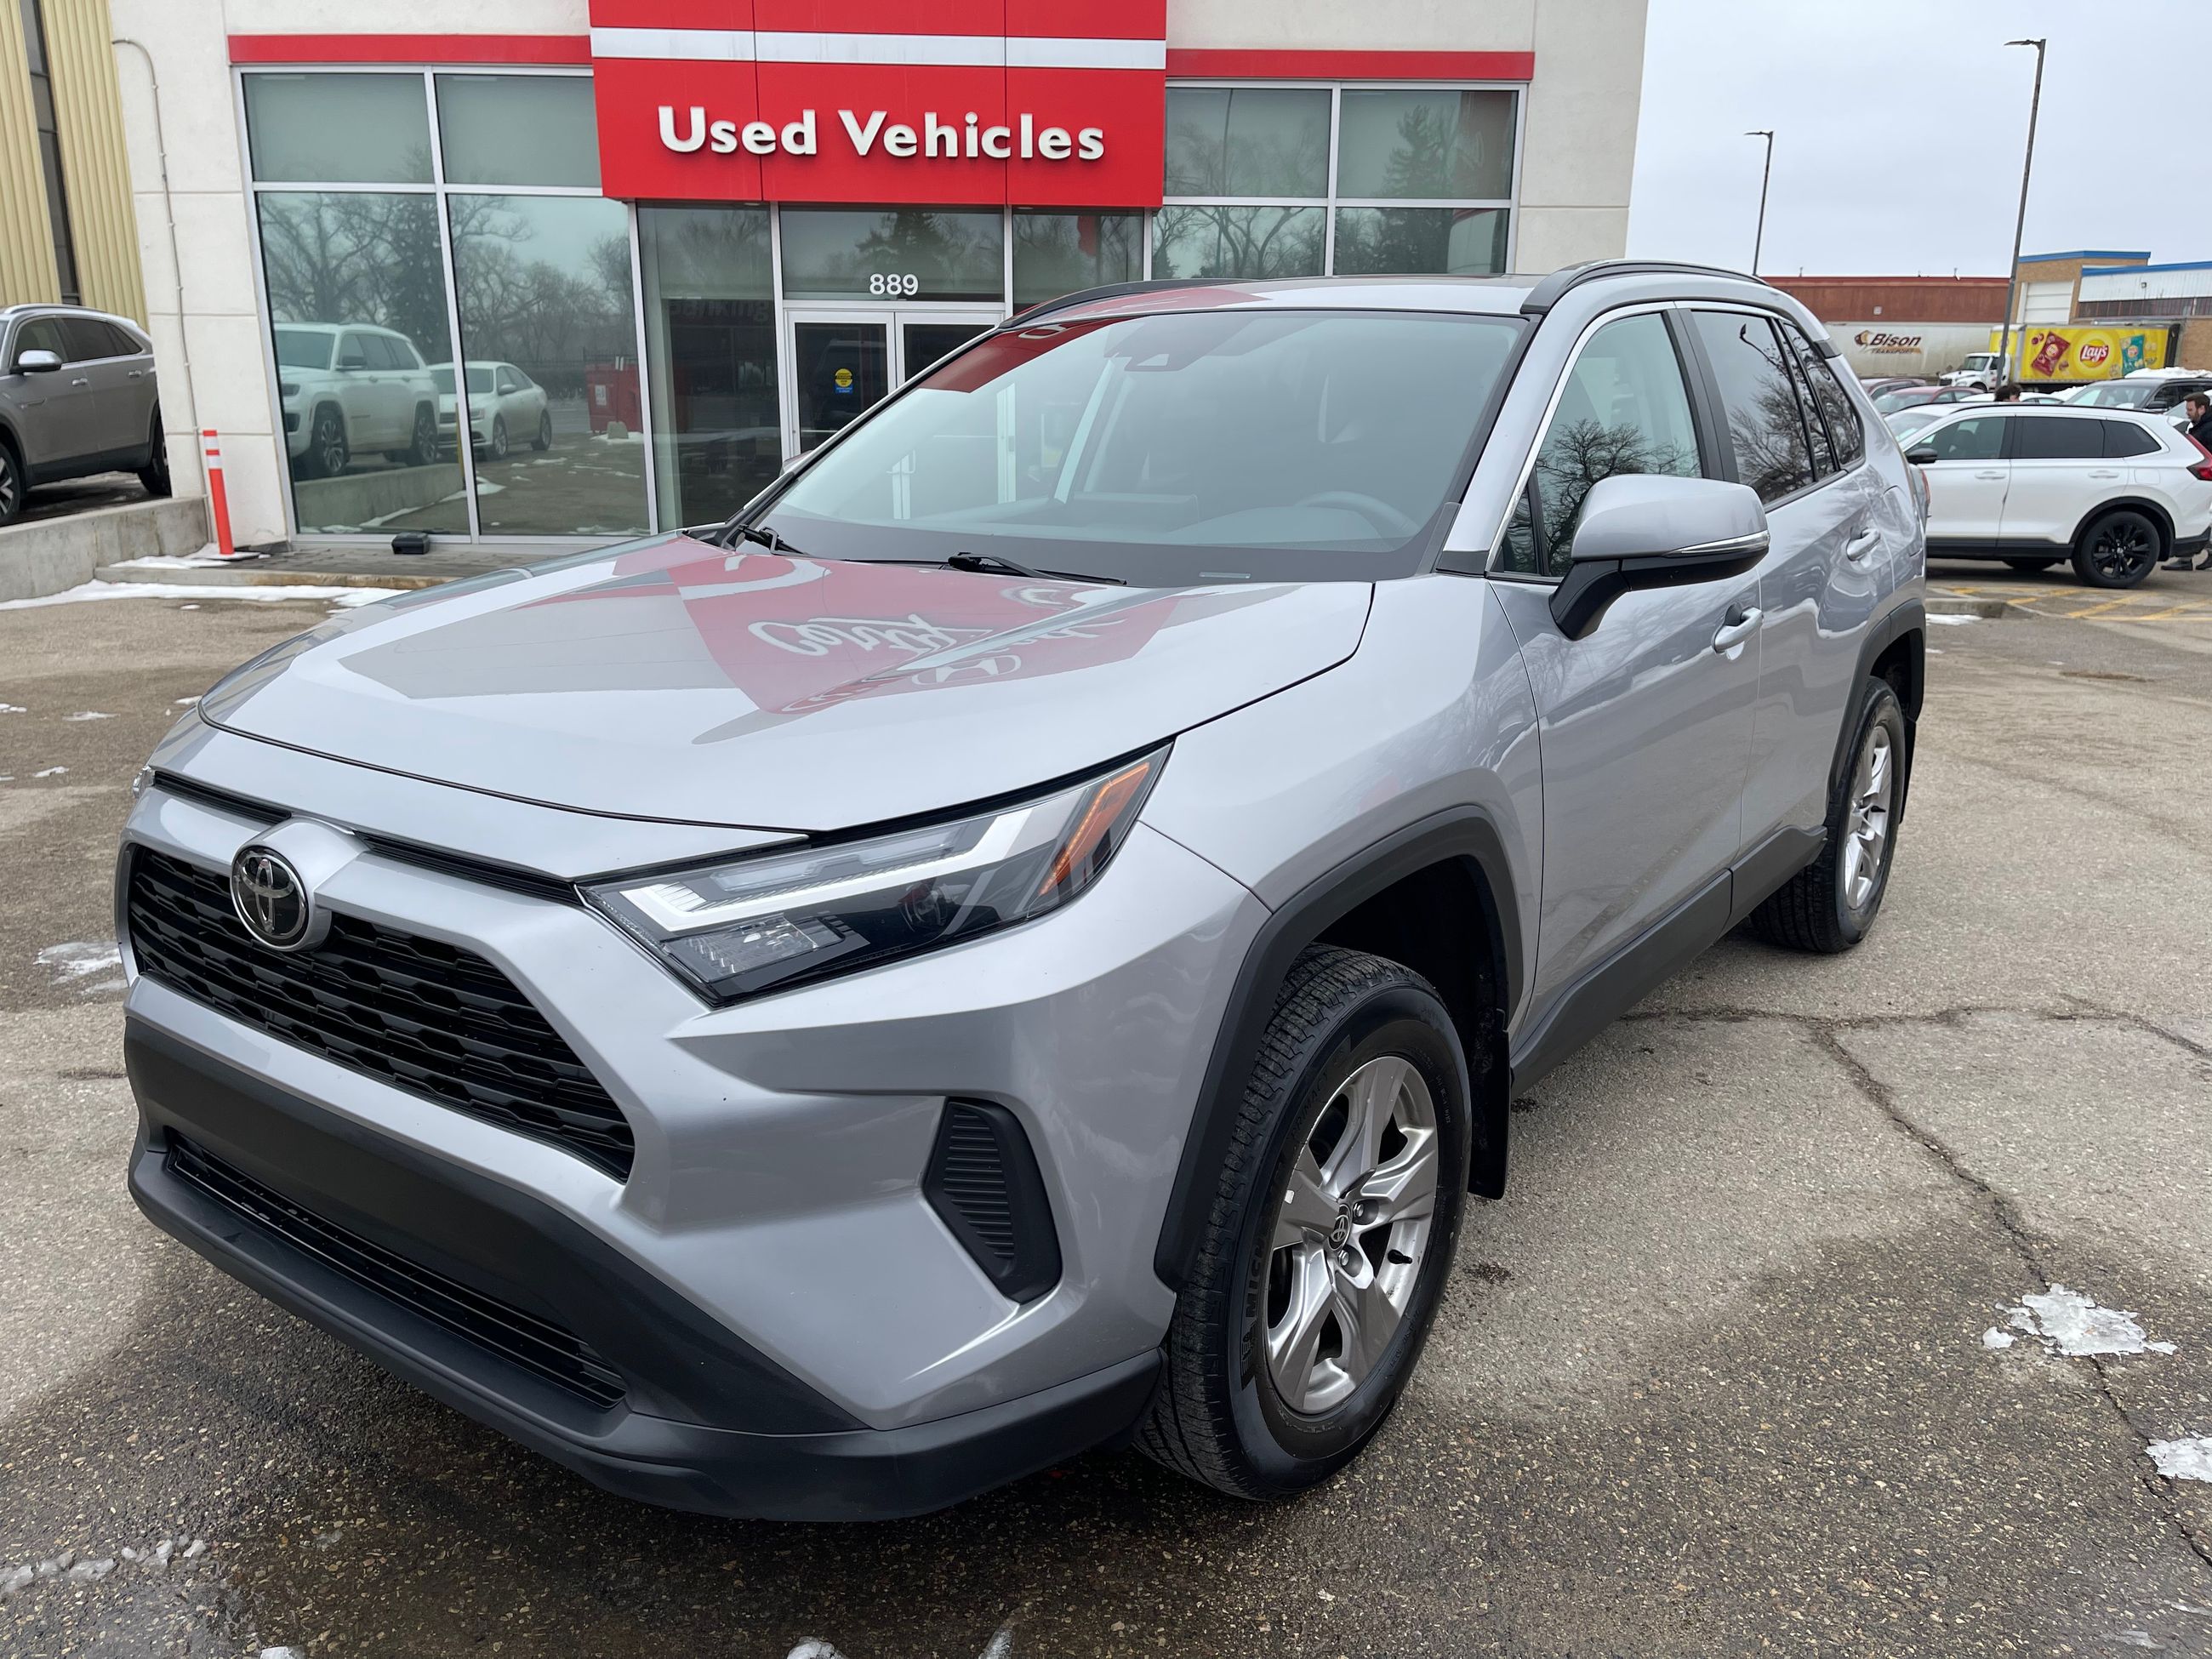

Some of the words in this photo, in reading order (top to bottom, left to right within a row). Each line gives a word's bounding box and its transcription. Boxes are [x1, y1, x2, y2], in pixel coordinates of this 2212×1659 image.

[658, 105, 817, 154] Used
[838, 109, 1104, 160] Vehicles
[869, 273, 919, 295] 889
[1870, 334, 1921, 346] Bison
[2081, 345, 2107, 362] Lay's
